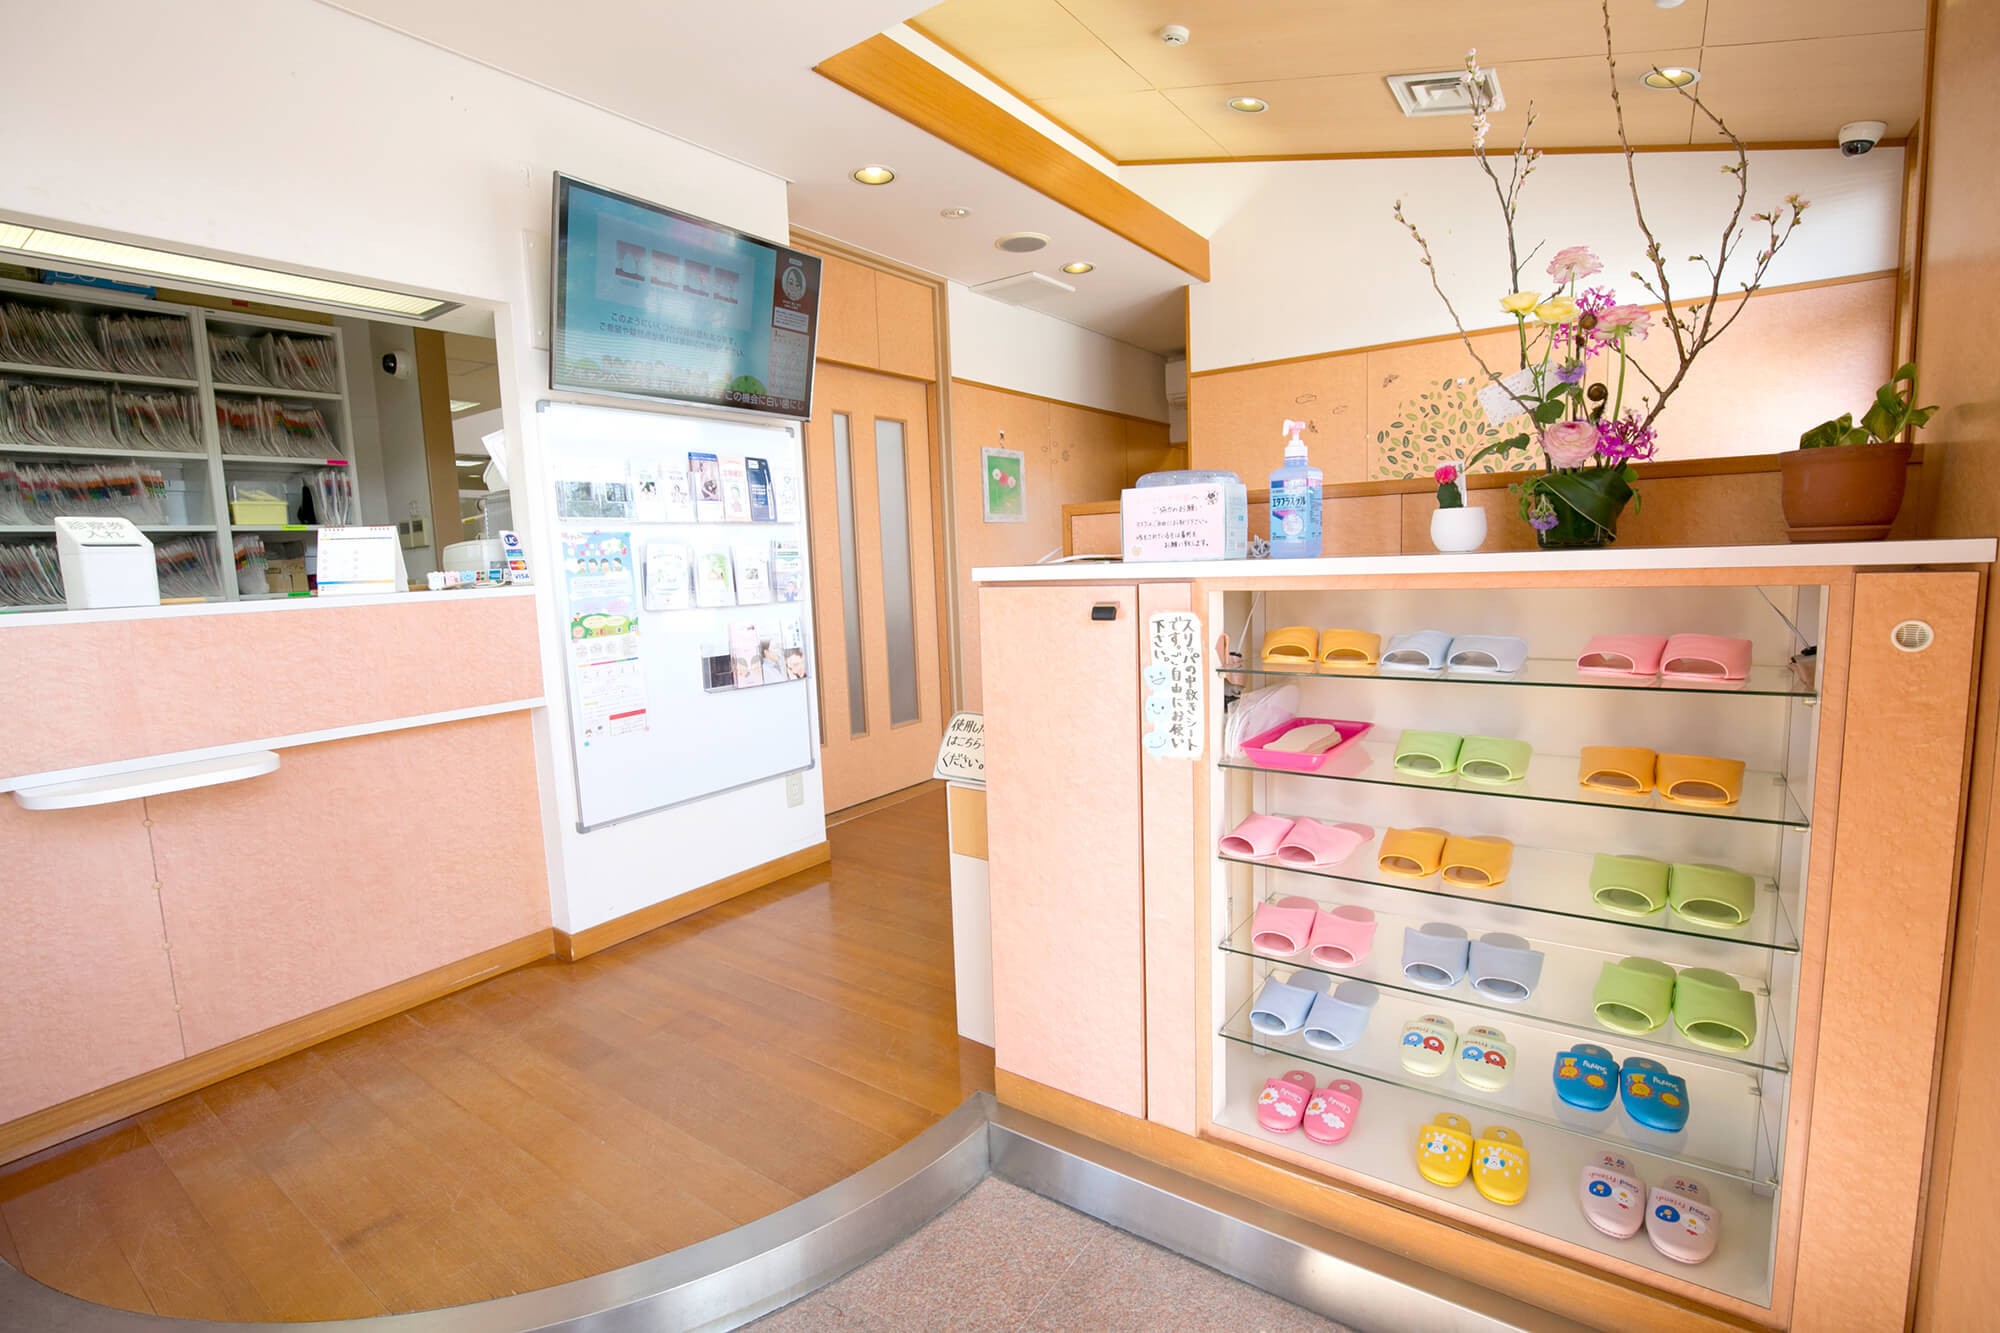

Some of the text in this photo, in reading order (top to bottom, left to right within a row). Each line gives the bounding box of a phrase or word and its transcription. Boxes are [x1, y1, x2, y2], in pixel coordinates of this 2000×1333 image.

[1152, 619, 1169, 663] 下さい。
[1168, 616, 1185, 748] です。ご自由にお使い
[1182, 619, 1200, 751] スリッパの中敷きシート
[946, 735, 984, 750] はこちら
[942, 752, 984, 769] ください。
[1582, 1060, 1608, 1075] Sunny
[1652, 1076, 1680, 1093] Sunny
[1328, 1096, 1351, 1114] Cloudy
